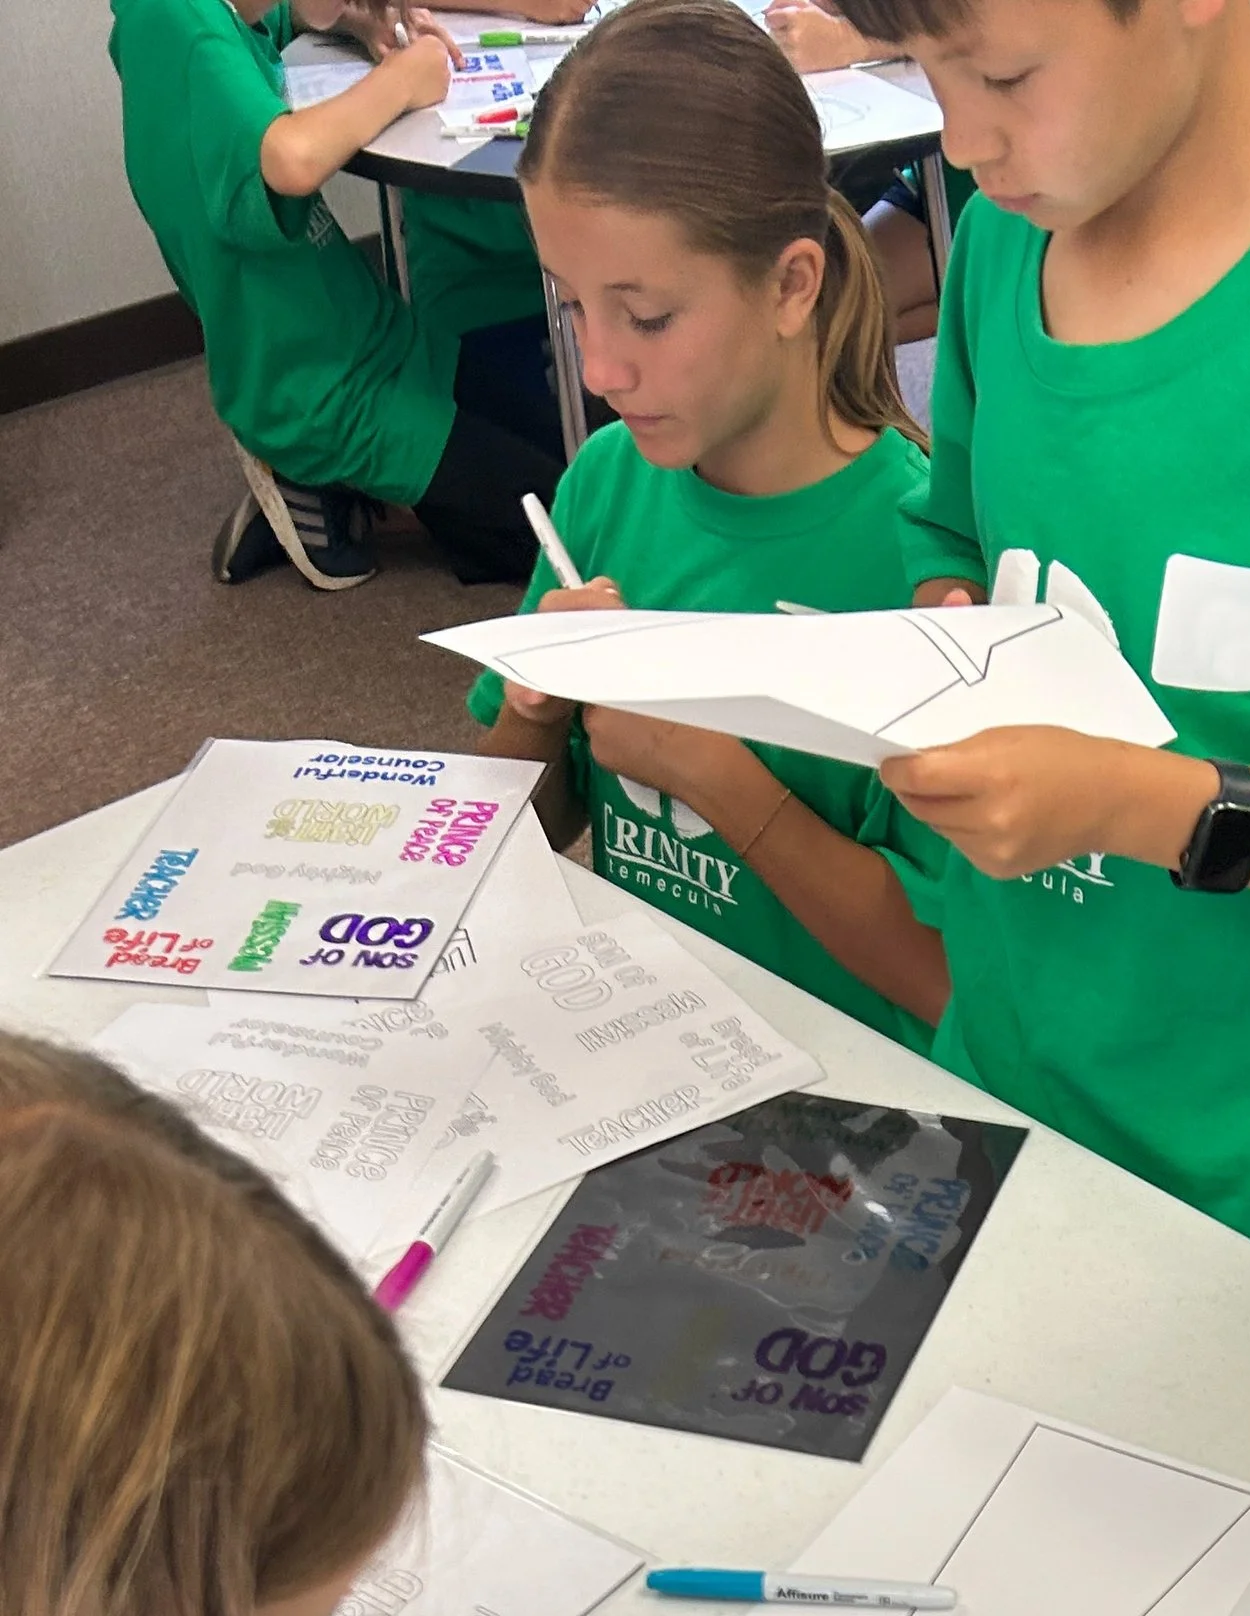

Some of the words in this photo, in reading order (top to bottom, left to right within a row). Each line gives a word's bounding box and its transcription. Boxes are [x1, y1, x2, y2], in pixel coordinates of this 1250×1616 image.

[293, 767, 437, 787] Wonderful
[310, 753, 446, 773] Counselor
[608, 858, 723, 917] temecula
[318, 913, 436, 949] GOD
[104, 950, 202, 976] Bread
[351, 950, 419, 969] SON
[520, 945, 614, 1013] GOD
[755, 1327, 887, 1388] GOD
[505, 1361, 614, 1402] Bread
